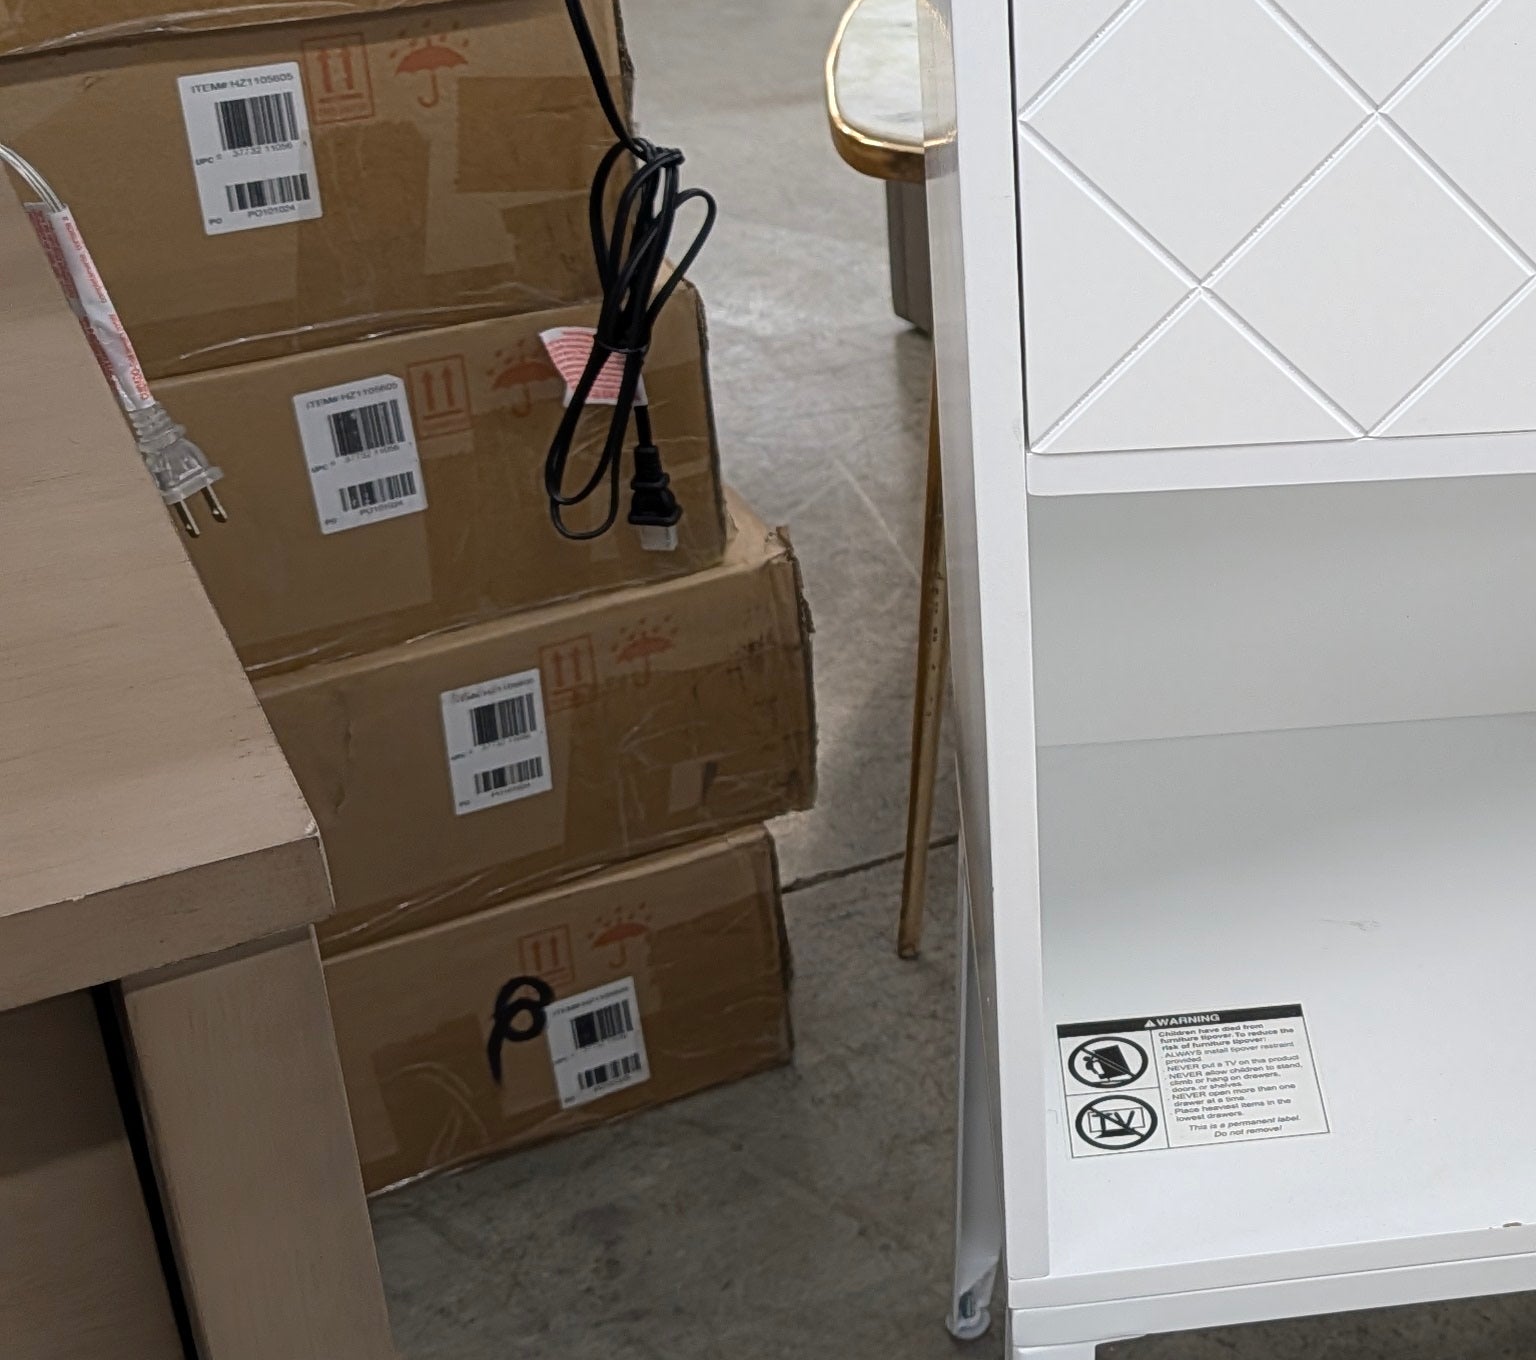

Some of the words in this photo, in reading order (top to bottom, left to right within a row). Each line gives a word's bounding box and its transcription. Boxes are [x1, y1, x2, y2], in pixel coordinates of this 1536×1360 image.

[1156, 1014, 1221, 1027] WARNING
[1159, 1029, 1196, 1038] Children
[1165, 1050, 1201, 1058] ALWAYS
[1167, 1064, 1199, 1072] NEVER
[1169, 1071, 1203, 1079] NEVER
[1205, 1068, 1227, 1076] allow
[1229, 1066, 1264, 1074] children
[1207, 1075, 1229, 1083] hang
[1172, 1091, 1207, 1100] NEVER
[1174, 1099, 1205, 1107] drawer
[1176, 1114, 1205, 1122] lowest
[1228, 1118, 1276, 1128] permanent
